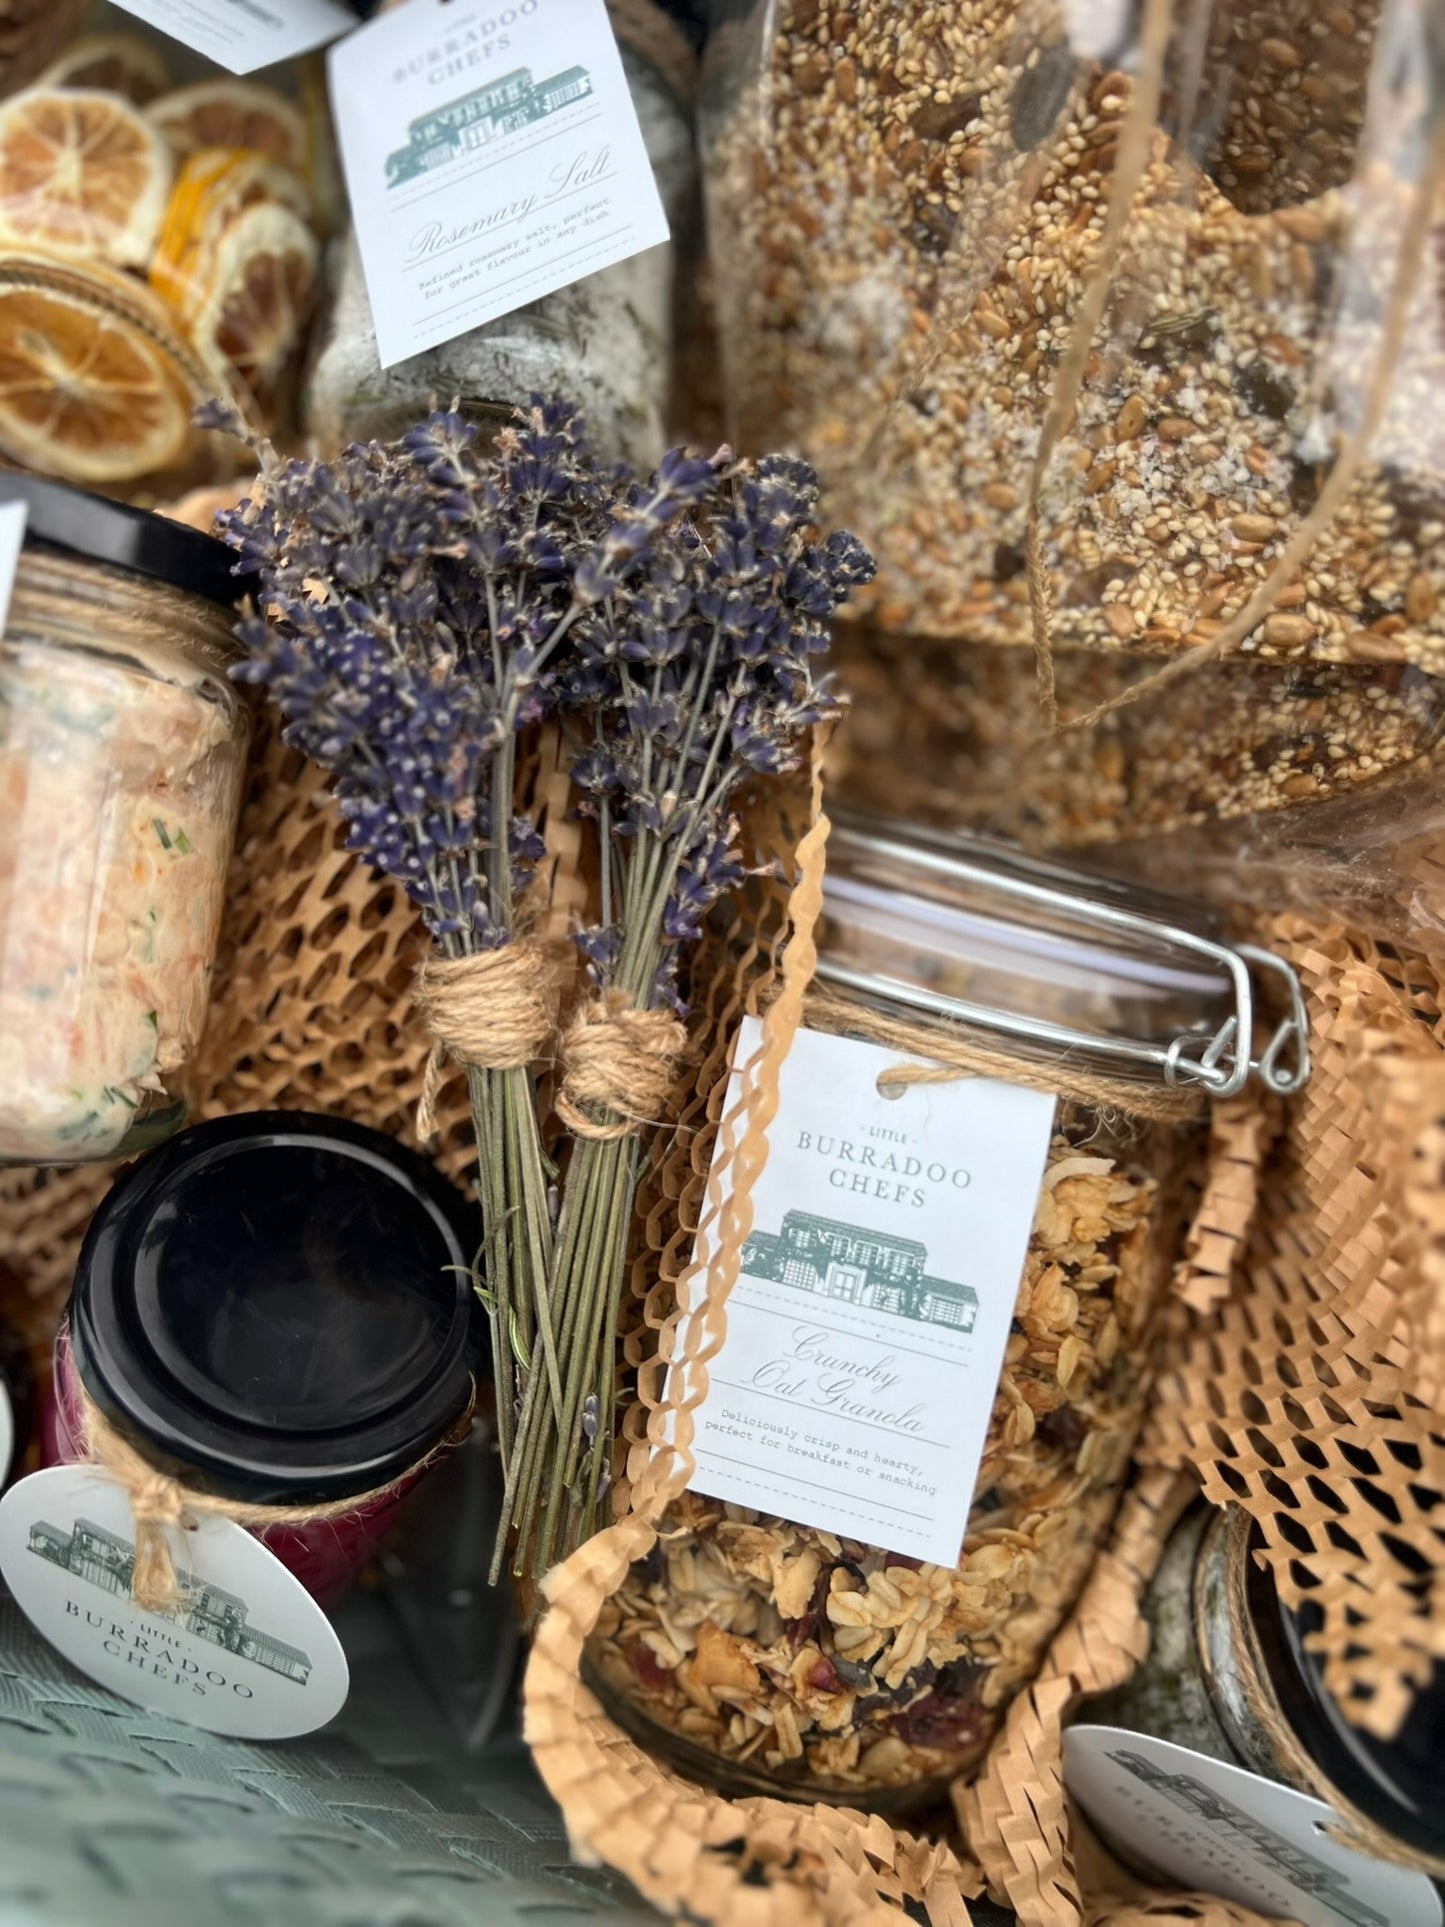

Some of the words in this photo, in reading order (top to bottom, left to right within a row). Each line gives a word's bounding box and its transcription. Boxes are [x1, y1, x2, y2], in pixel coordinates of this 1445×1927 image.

[428, 33, 511, 85] CHEFS
[406, 194, 538, 263] Rosemary
[544, 144, 610, 199] Salt
[419, 264, 463, 291] Refined
[468, 239, 520, 268] rosemary
[525, 223, 557, 242] salt,
[563, 198, 611, 223] perfect
[425, 286, 443, 299] for
[449, 270, 481, 289] great
[487, 247, 531, 271] flavour
[538, 237, 551, 249] in
[556, 224, 577, 239] any
[582, 210, 609, 227] dish
[797, 1130, 971, 1189] BURRADOO
[869, 1125, 907, 1144] LITTLE
[829, 1168, 926, 1208] CHEFS
[782, 1325, 902, 1394] Crunchy
[739, 1359, 807, 1397] Oat
[810, 1372, 926, 1433] Granola
[704, 1420, 753, 1441] perfect
[759, 1434, 781, 1449] for
[787, 1441, 850, 1470] breakfast
[856, 1464, 872, 1476] or
[879, 1472, 937, 1496] snacking
[721, 1408, 798, 1440] Deliciously
[804, 1430, 840, 1451] crisp
[846, 1445, 868, 1459] and
[874, 1452, 923, 1476] hearty,
[65, 1600, 253, 1698] BURRADOO
[103, 1640, 206, 1696] CHEFS
[140, 1623, 182, 1648] LITTLE
